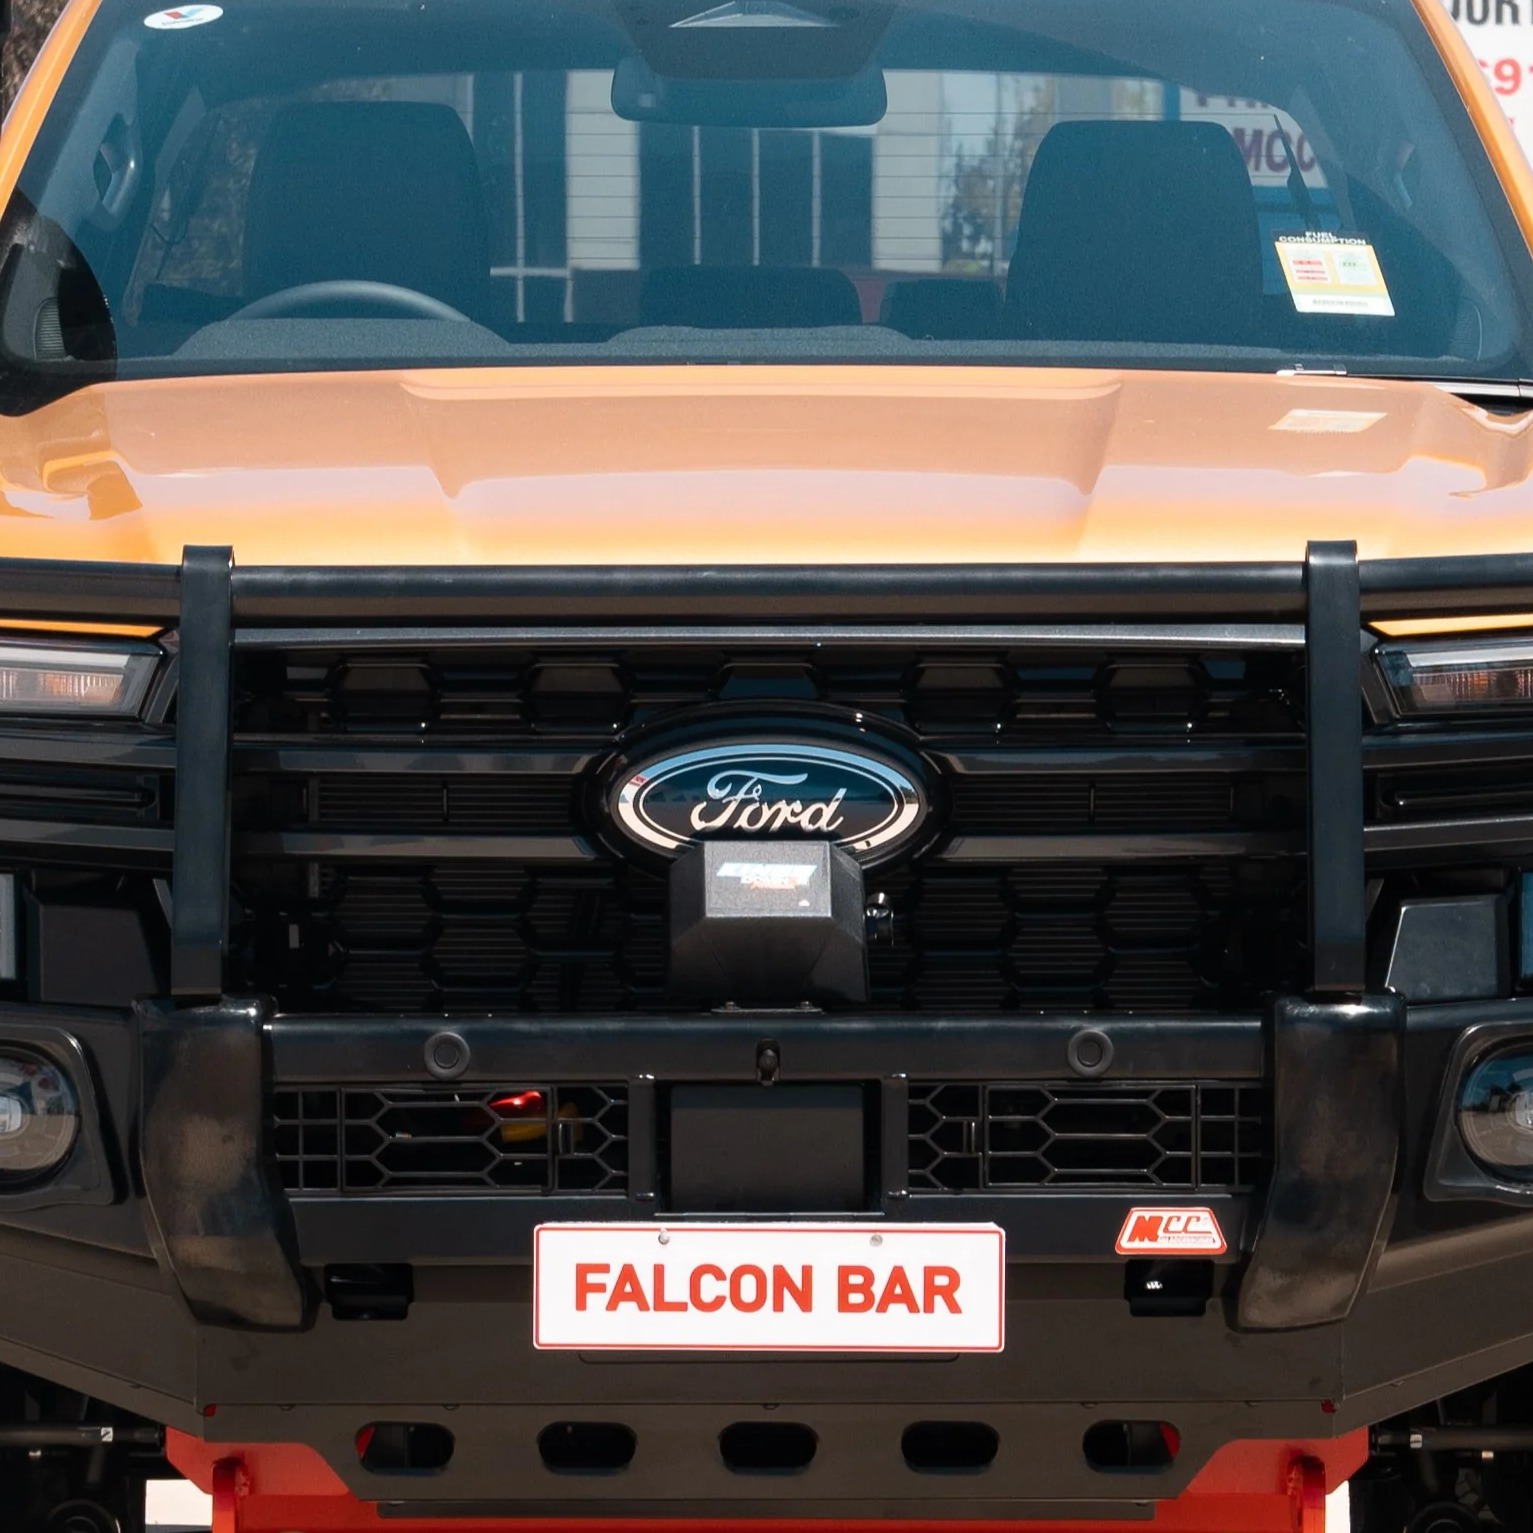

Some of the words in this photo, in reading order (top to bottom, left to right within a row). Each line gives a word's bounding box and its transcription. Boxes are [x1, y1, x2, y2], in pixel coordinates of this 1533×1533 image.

[690, 769, 847, 831] Ford
[1127, 1215, 1213, 1242] MCC
[575, 1263, 813, 1312] FALCON
[837, 1264, 963, 1314] BAR
